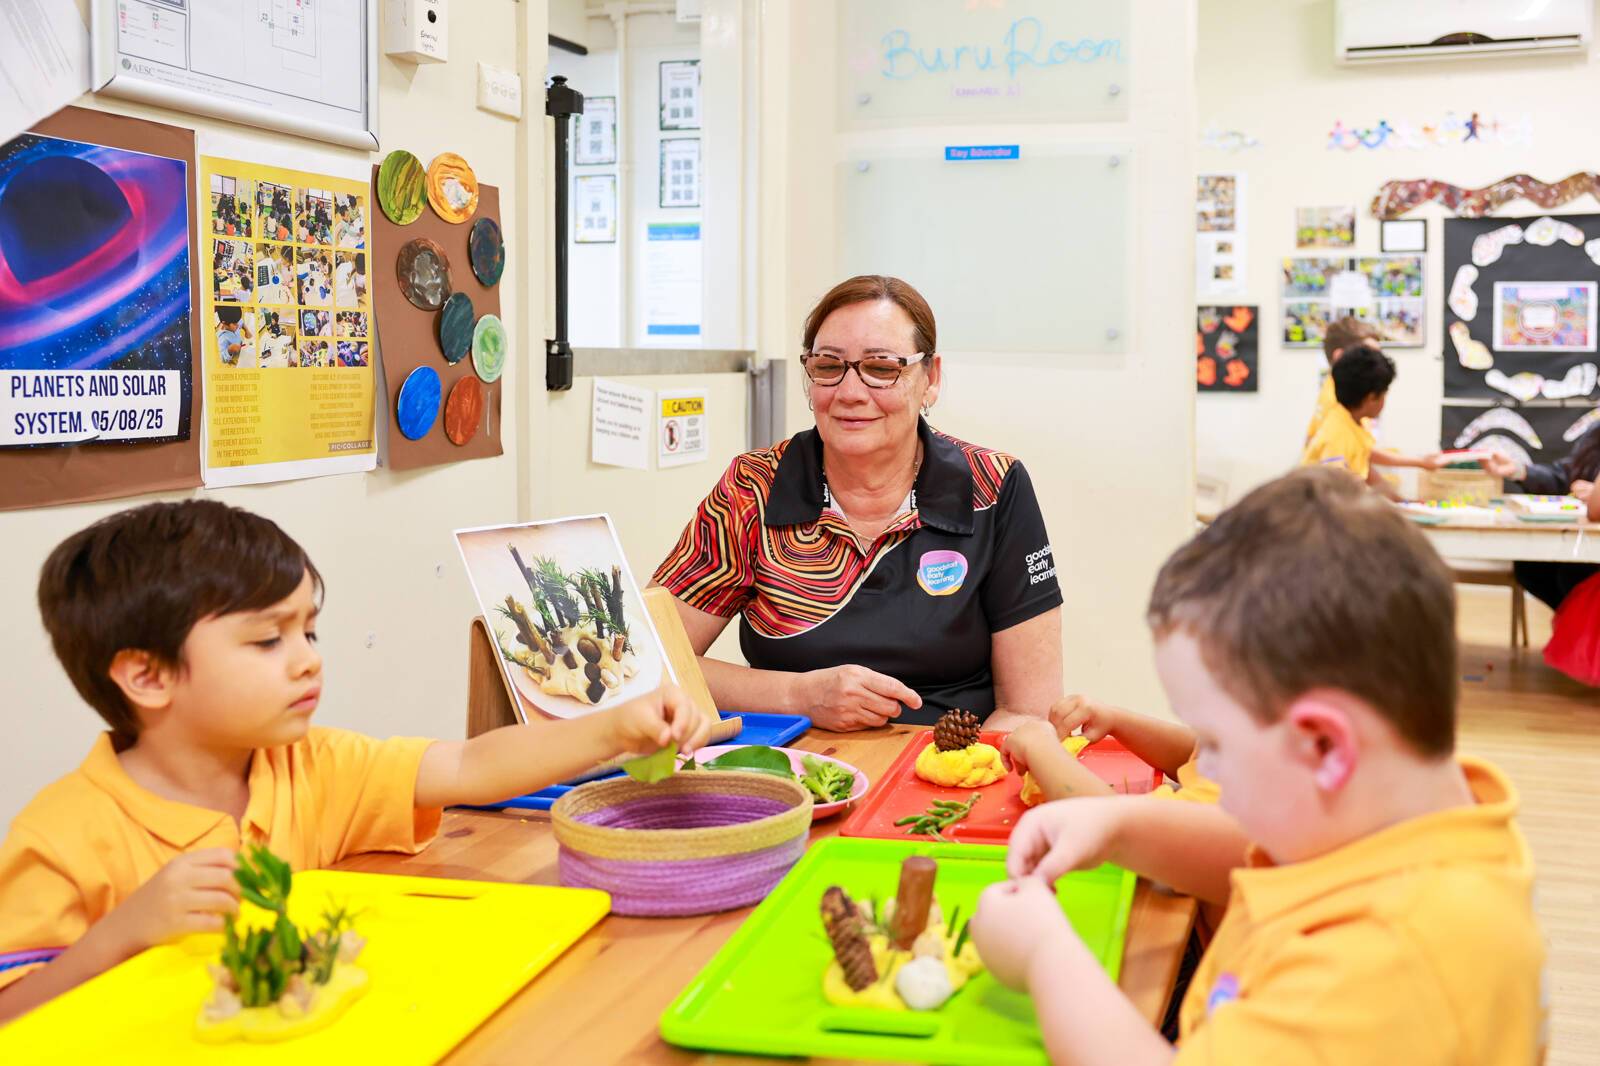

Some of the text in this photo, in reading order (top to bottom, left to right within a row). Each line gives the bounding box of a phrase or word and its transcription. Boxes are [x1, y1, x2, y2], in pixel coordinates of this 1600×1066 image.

[881, 16, 1124, 80] Buru Room
[11, 375, 166, 398] PLANETS AND SOLAR
[672, 400, 702, 413] CAUTION
[14, 409, 163, 435] SYSTEM. 05/08/25
[1028, 559, 1048, 574] early
